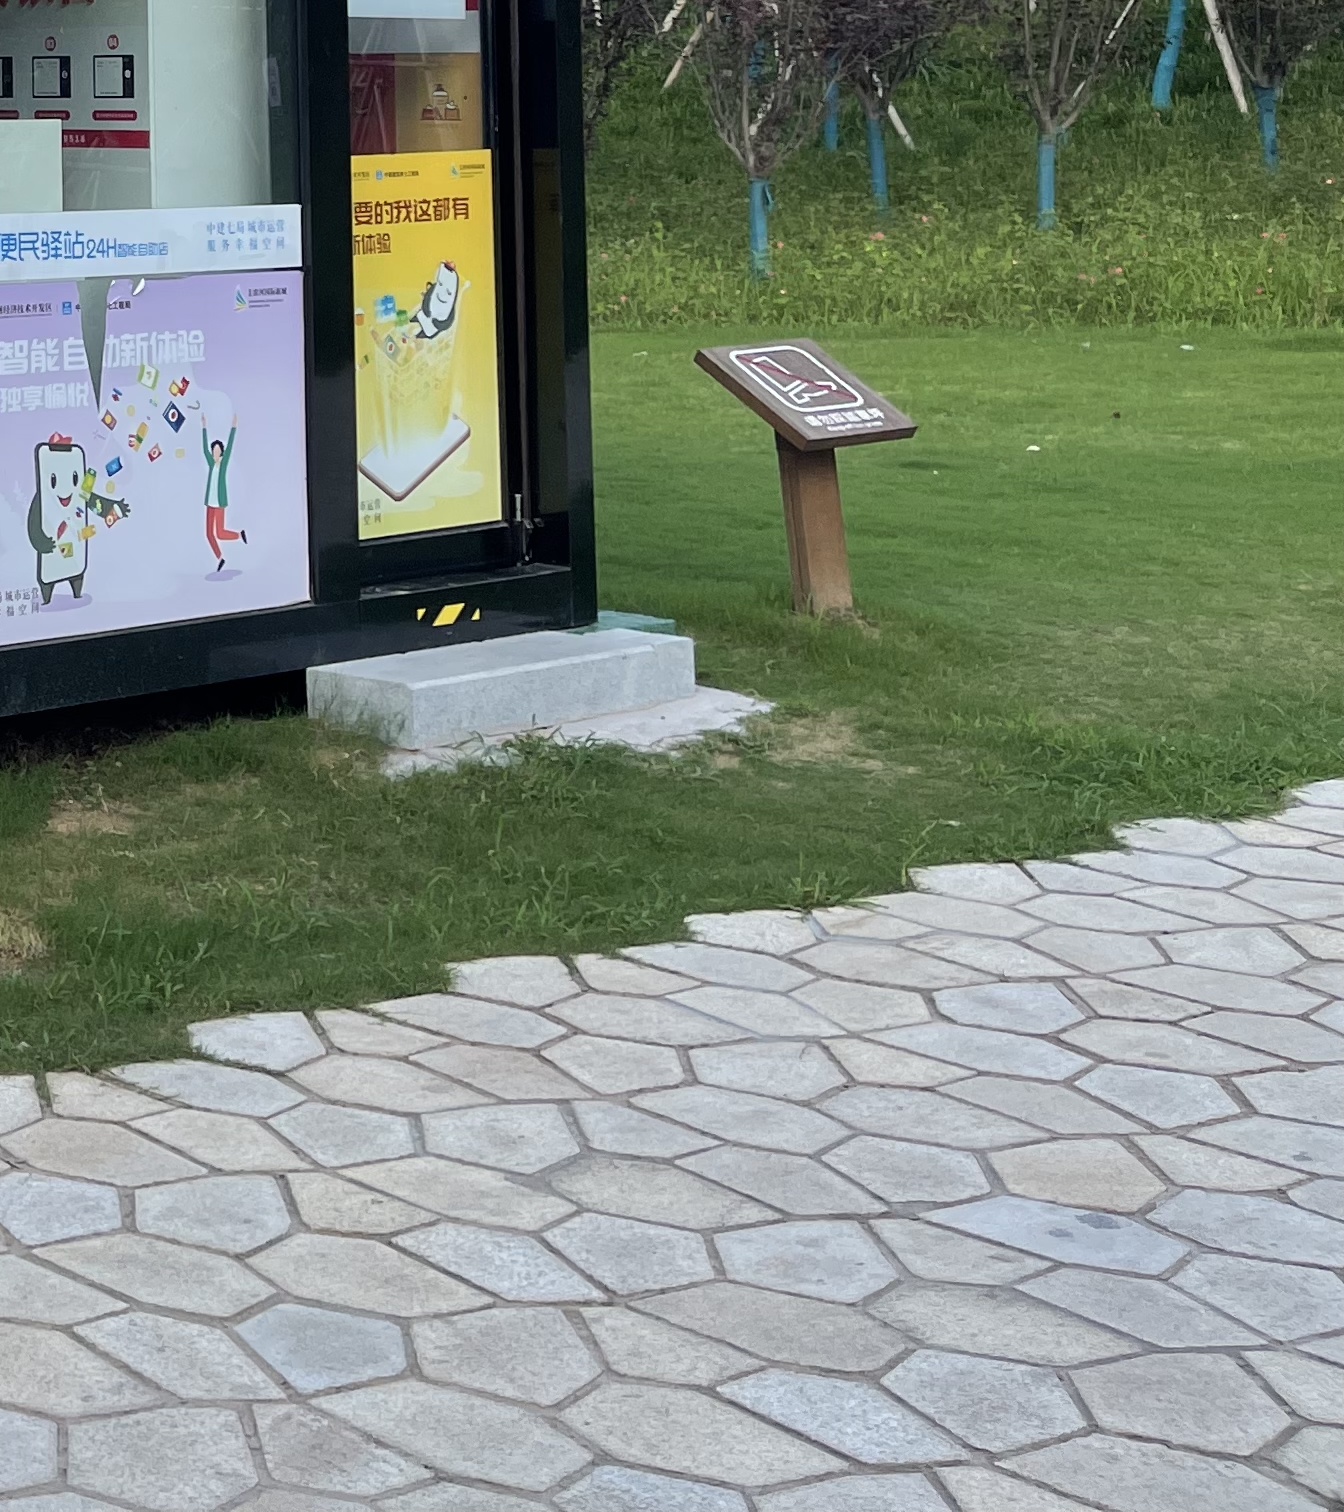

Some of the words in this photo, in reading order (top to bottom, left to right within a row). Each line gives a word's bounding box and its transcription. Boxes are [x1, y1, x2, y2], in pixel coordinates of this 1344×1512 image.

[353, 196, 470, 226] 要的我这都有
[0, 381, 90, 414] 独享愉悦
